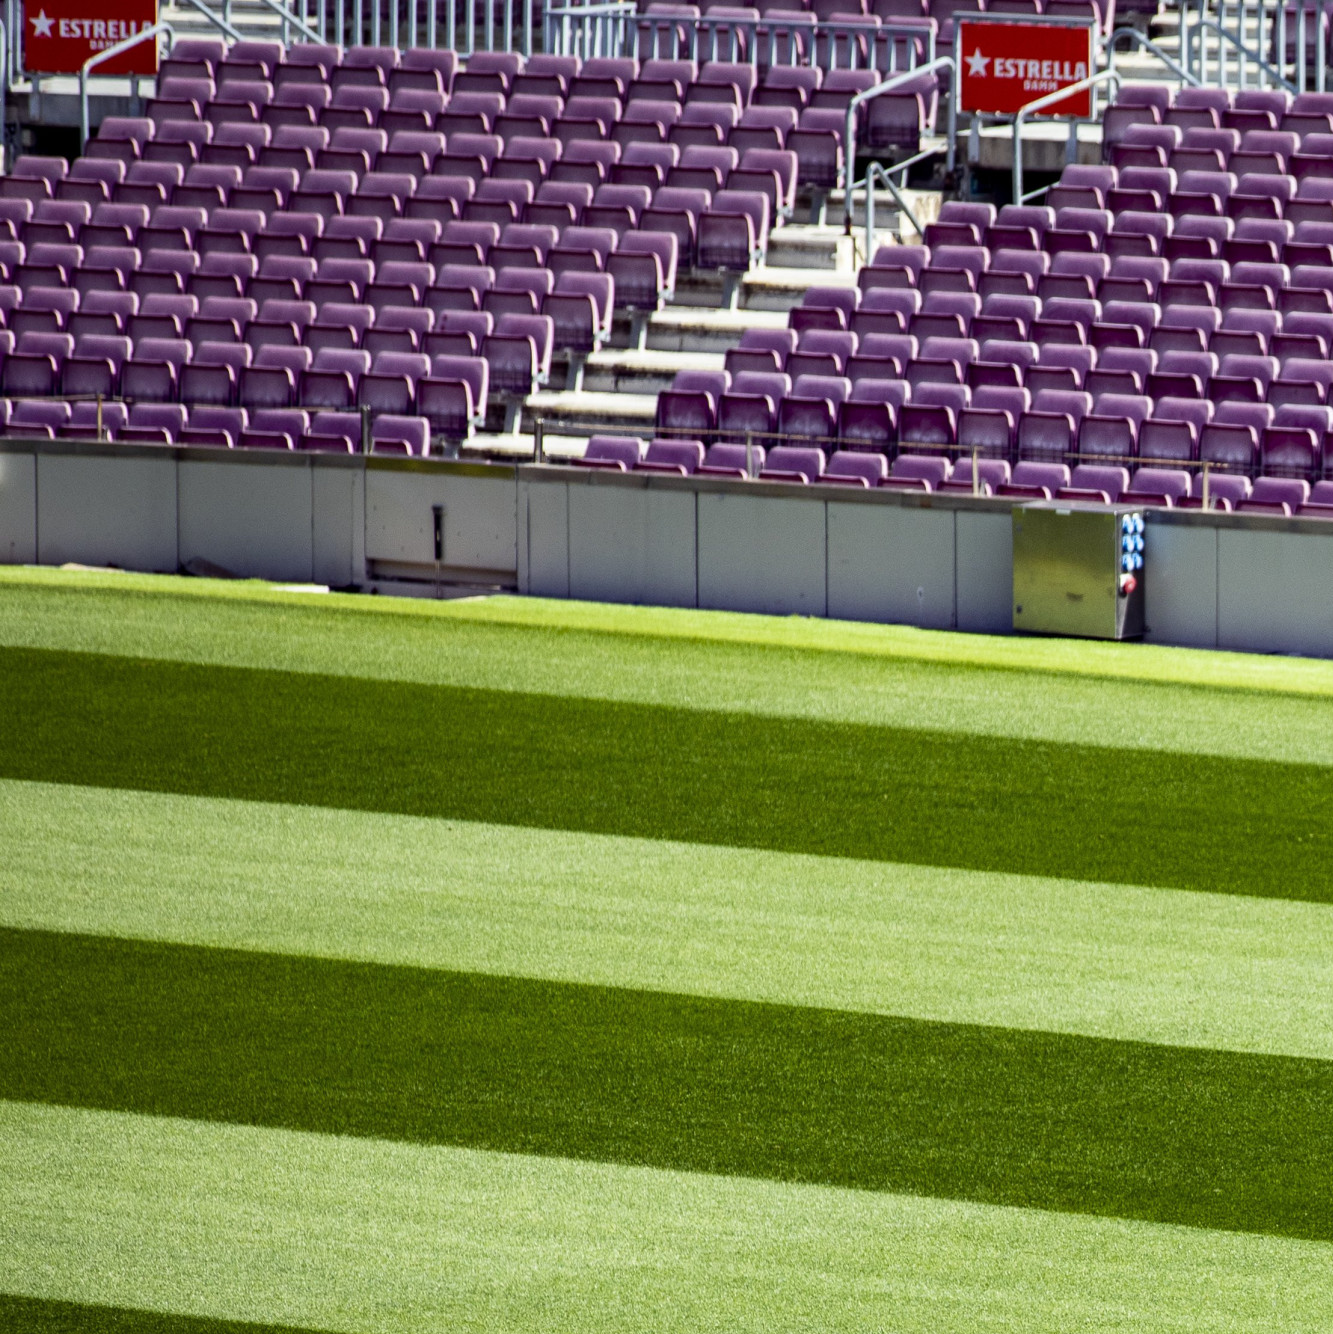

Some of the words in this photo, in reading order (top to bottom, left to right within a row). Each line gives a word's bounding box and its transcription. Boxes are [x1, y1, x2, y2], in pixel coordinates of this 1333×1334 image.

[89, 39, 119, 50] DAM
[993, 57, 1087, 81] ESTRELLA
[1023, 79, 1058, 92] DAMM
